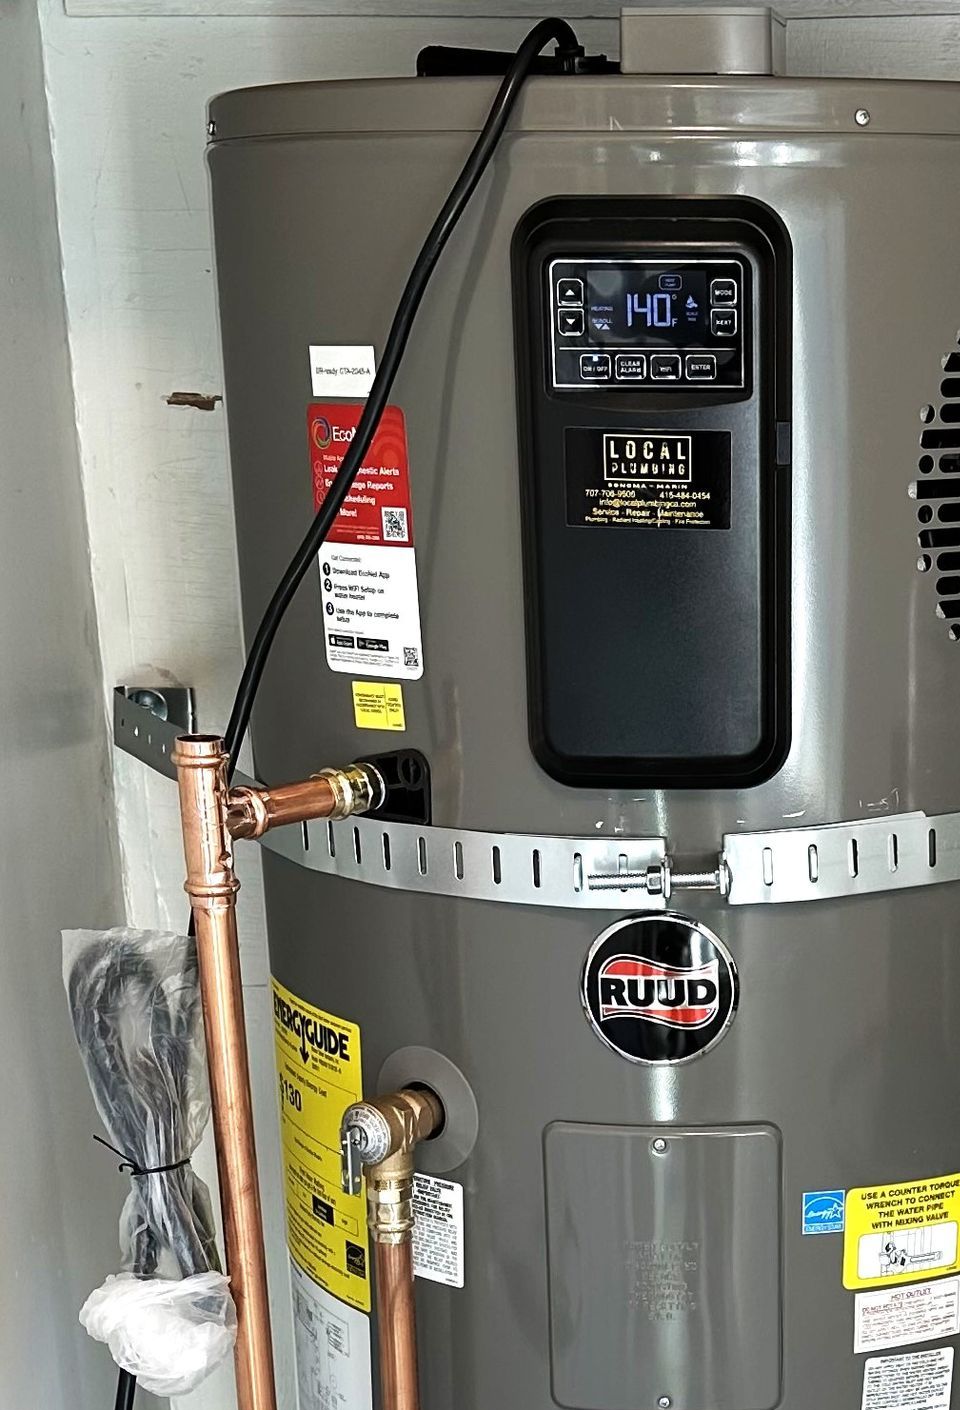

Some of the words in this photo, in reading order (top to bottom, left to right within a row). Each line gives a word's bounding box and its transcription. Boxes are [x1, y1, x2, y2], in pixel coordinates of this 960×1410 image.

[627, 294, 671, 327] 140
[610, 441, 686, 460] LOCAL
[612, 463, 685, 475] PLUMBING
[593, 508, 619, 516] Service
[626, 509, 650, 517] Repair
[600, 978, 717, 1007] RUUD
[861, 1192, 878, 1200] USE
[880, 1191, 886, 1199] A
[889, 1185, 927, 1197] COUNTER
[930, 1180, 960, 1192] TORQUE
[866, 1199, 903, 1210] WRENCH
[905, 1197, 916, 1205] TO
[918, 1191, 956, 1204] CONNECT
[878, 1210, 894, 1218] THE
[897, 1206, 924, 1216] WATER
[926, 1202, 944, 1211] PIPE
[872, 1220, 893, 1230] WITH
[895, 1216, 924, 1227] MIXING
[926, 1212, 949, 1221] VALVE
